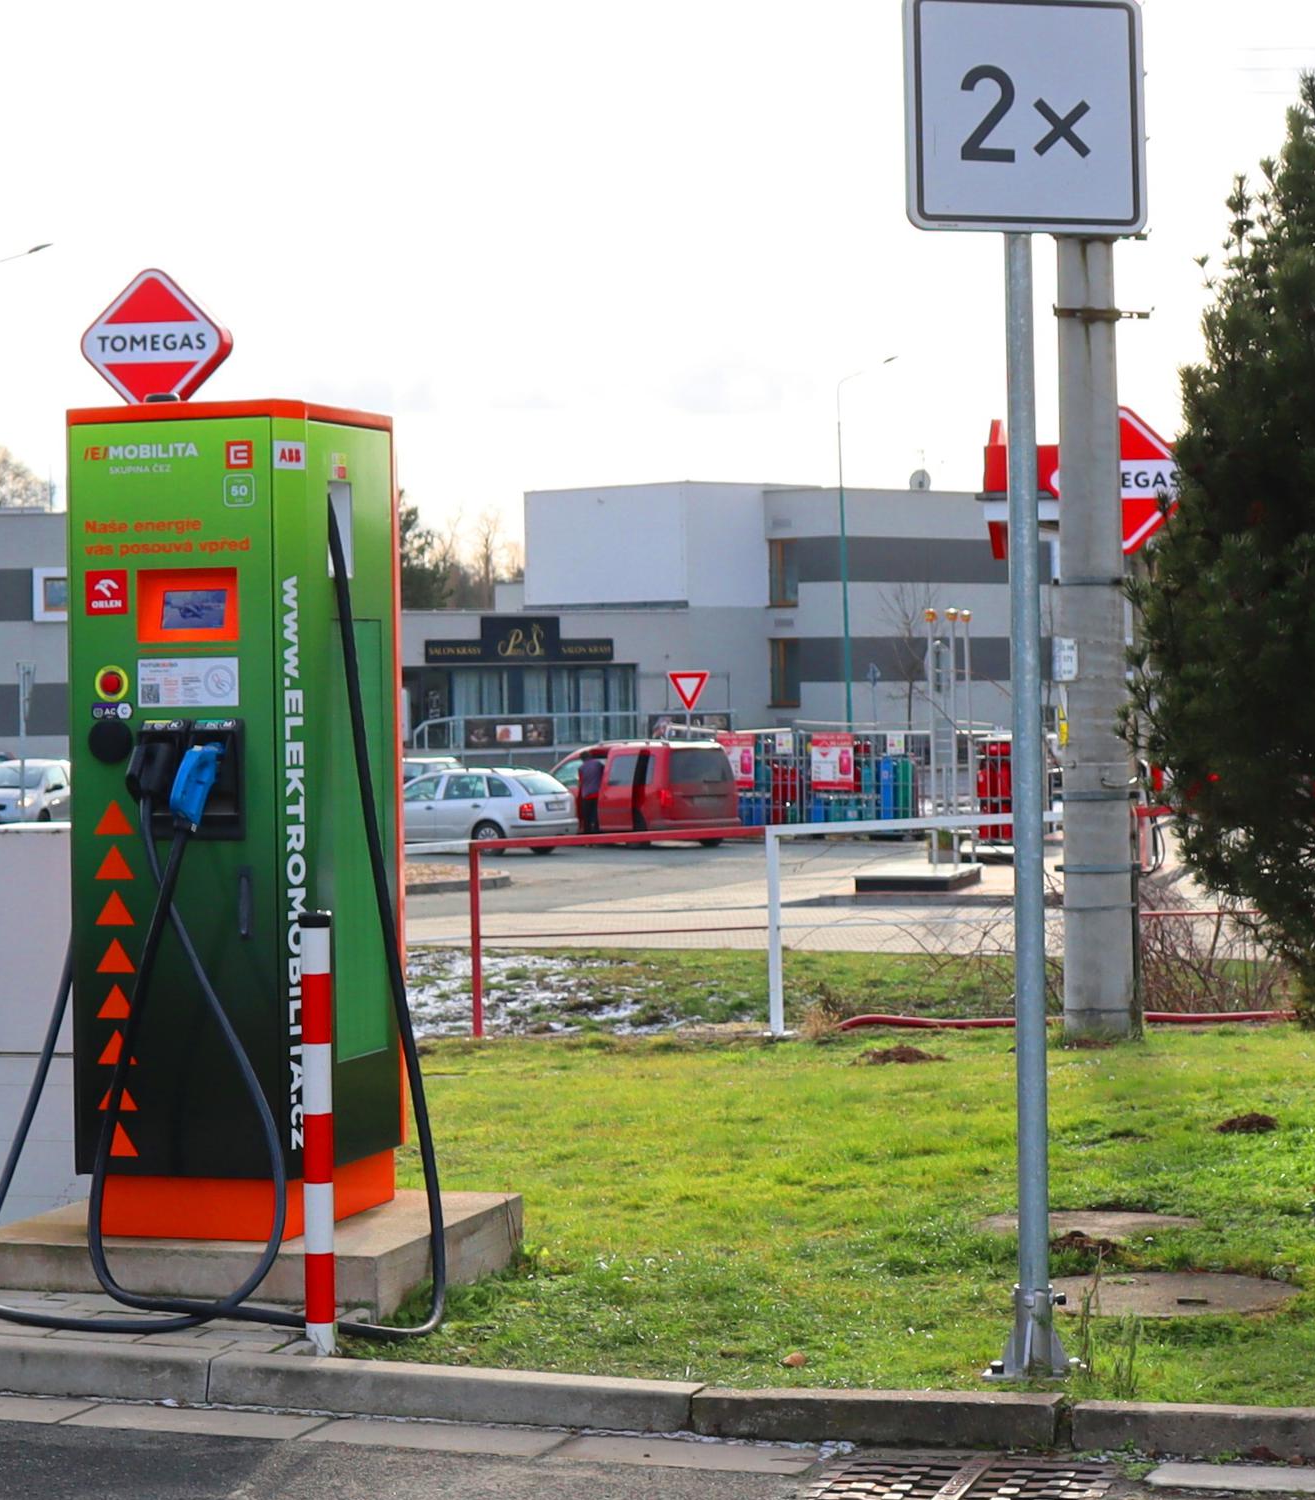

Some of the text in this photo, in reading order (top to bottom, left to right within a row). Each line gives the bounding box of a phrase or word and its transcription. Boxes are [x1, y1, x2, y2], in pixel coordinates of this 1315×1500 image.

[97, 332, 207, 353] TOMEGAS
[279, 448, 302, 463] ABB
[1121, 471, 1180, 488] EGAS
[231, 485, 248, 496] 50
[85, 519, 202, 535] Naše energie
[91, 599, 122, 609] ORLEN
